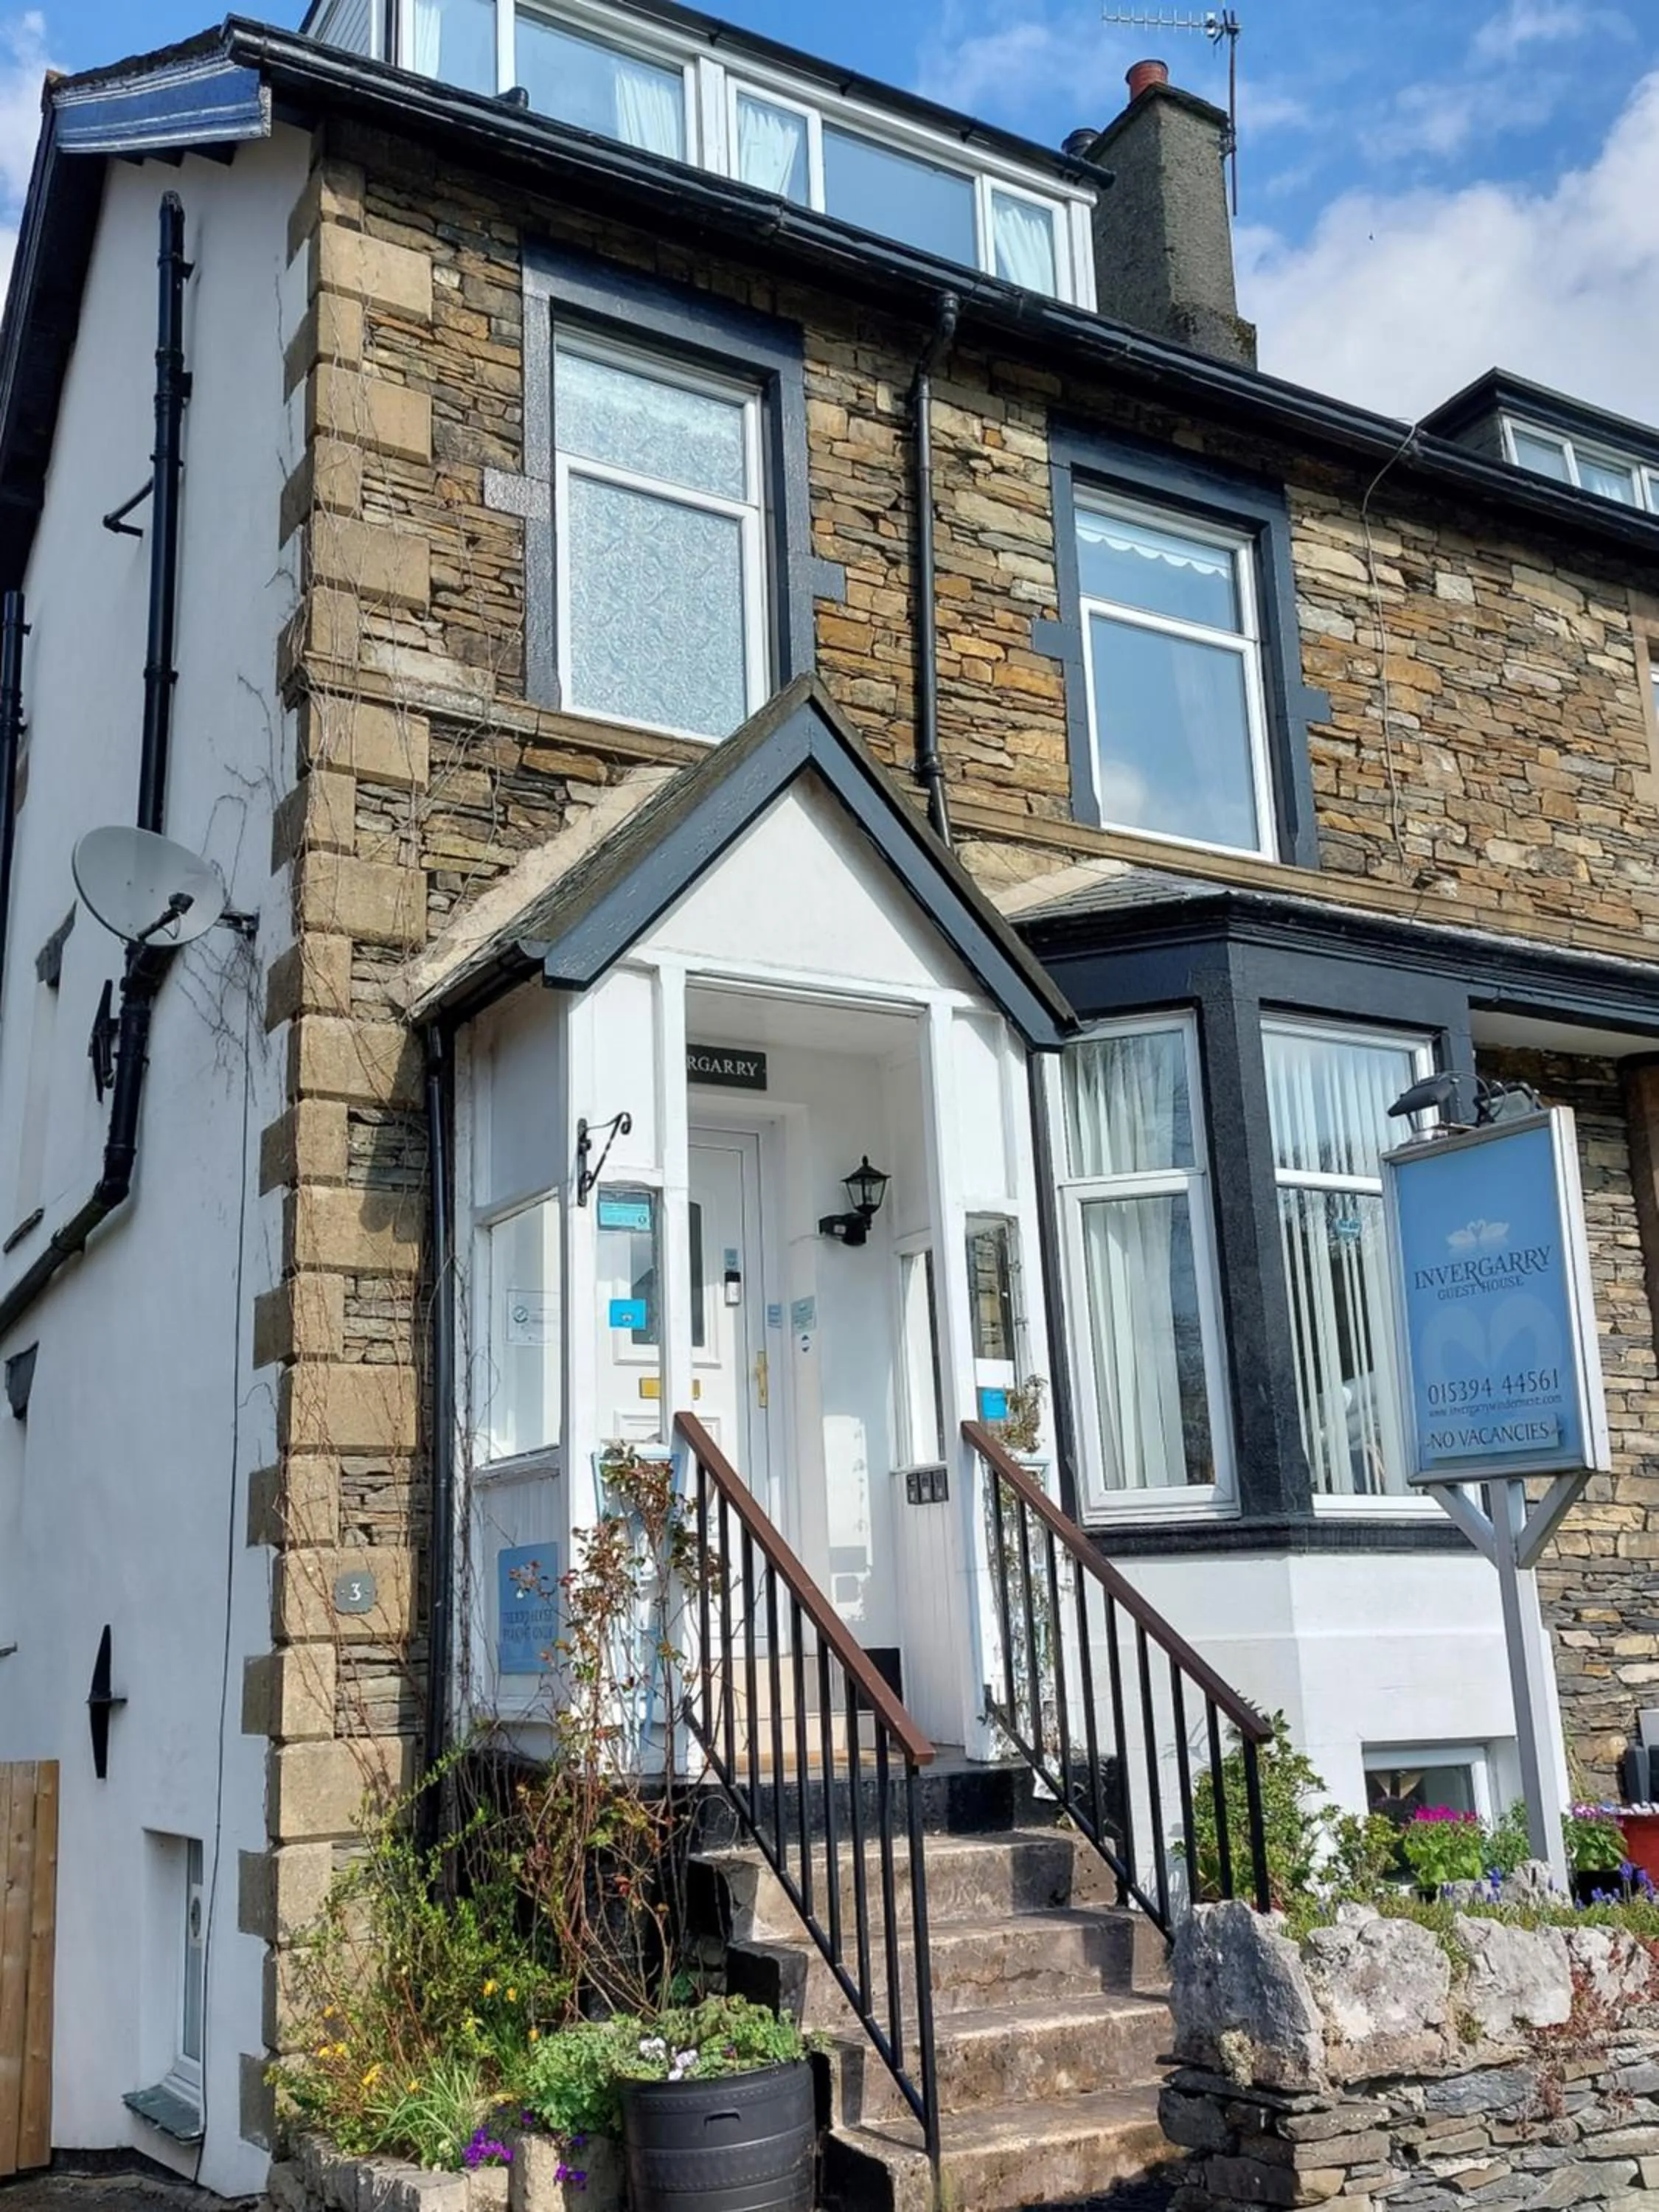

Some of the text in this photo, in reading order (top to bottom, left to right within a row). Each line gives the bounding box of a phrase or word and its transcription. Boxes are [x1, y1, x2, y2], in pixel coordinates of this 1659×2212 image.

[686, 1055, 758, 1077] RGARRY
[1414, 1246, 1551, 1290] INVERGARRY
[1438, 1275, 1525, 1301] GUEST HOUSE
[1427, 1368, 1559, 1405] 015394 44561
[1458, 1422, 1549, 1447] VACANCIES
[349, 1582, 361, 1601] 3
